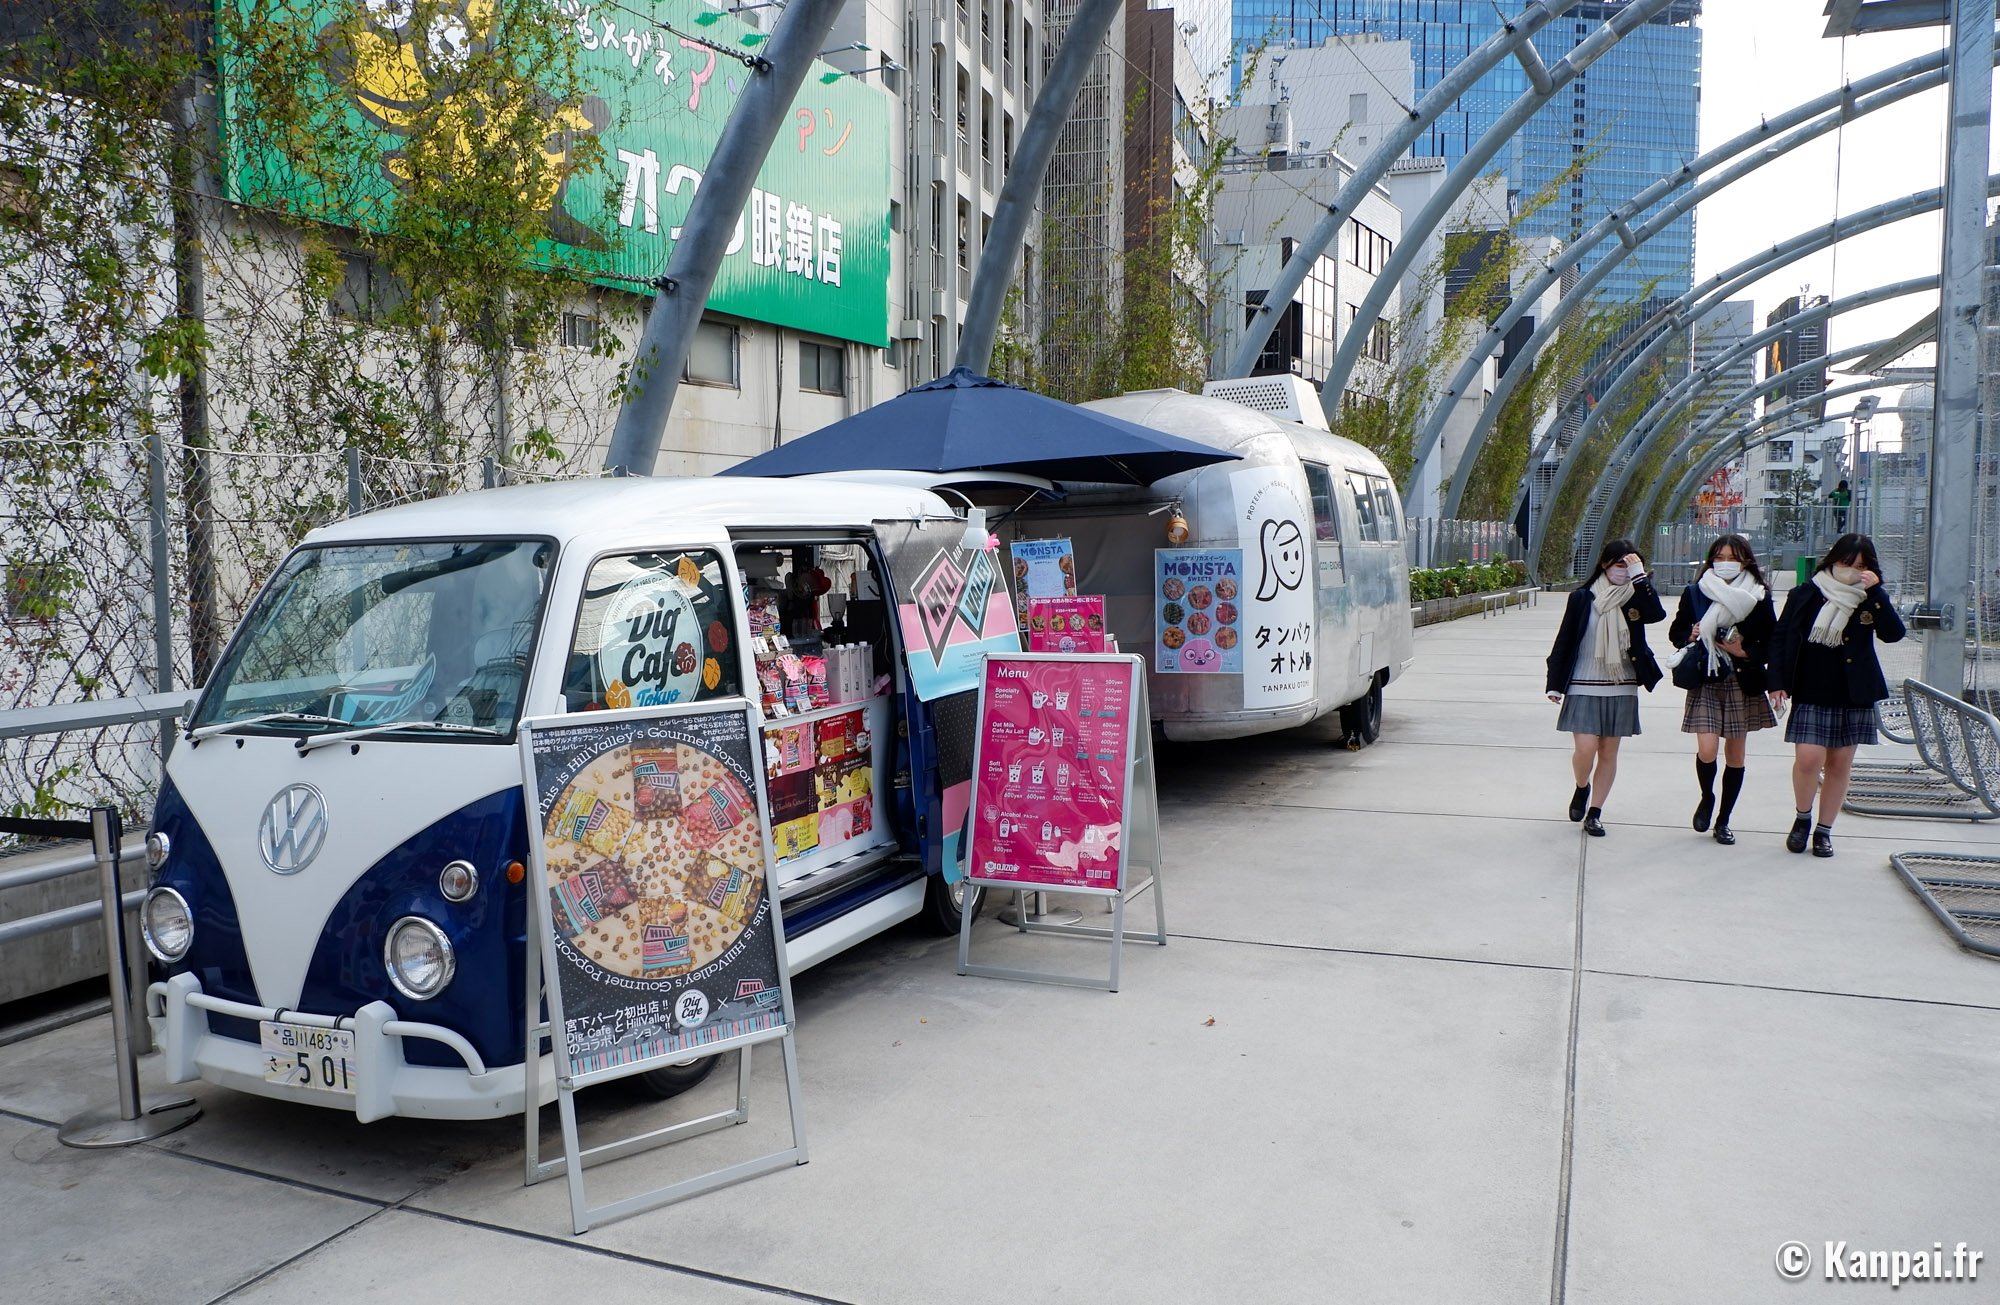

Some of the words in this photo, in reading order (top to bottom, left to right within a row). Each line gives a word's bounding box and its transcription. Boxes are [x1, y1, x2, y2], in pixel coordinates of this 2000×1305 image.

[616, 147, 842, 288] オ眼鏡店
[1246, 489, 1263, 520] PROTEIN
[1164, 562, 1236, 576] MONSTA
[964, 555, 991, 622] VALLEY
[625, 597, 682, 650] Dig
[1254, 621, 1311, 650] タンパク
[1270, 649, 1305, 675] オトメ
[997, 667, 1029, 678] Menu
[1262, 682, 1296, 693] TANPAKU
[636, 688, 682, 707] Tokyo
[555, 771, 570, 785] is
[566, 728, 644, 773] HillValley's
[647, 727, 710, 749] Gourmet
[652, 776, 672, 785] HILL
[589, 807, 606, 827] HILL
[711, 808, 727, 826] HILL
[586, 877, 601, 900] HILL
[713, 881, 727, 901] HILL
[650, 929, 672, 938] HILL
[668, 937, 689, 948] VALLEY
[743, 927, 757, 941] is
[675, 940, 747, 988] HillValley's
[604, 974, 672, 992] Gourmet
[742, 983, 761, 993] HILL
[682, 996, 702, 1010] Dig
[565, 1000, 660, 1033] 宮下パーク初出店
[681, 1007, 703, 1020] Cafe
[566, 1032, 584, 1045] Dig
[587, 1025, 611, 1038] Cafe
[614, 1021, 624, 1033] と
[626, 1012, 672, 1030] HillValley
[568, 1025, 662, 1055] のコラボレーション
[269, 1056, 277, 1072] さ
